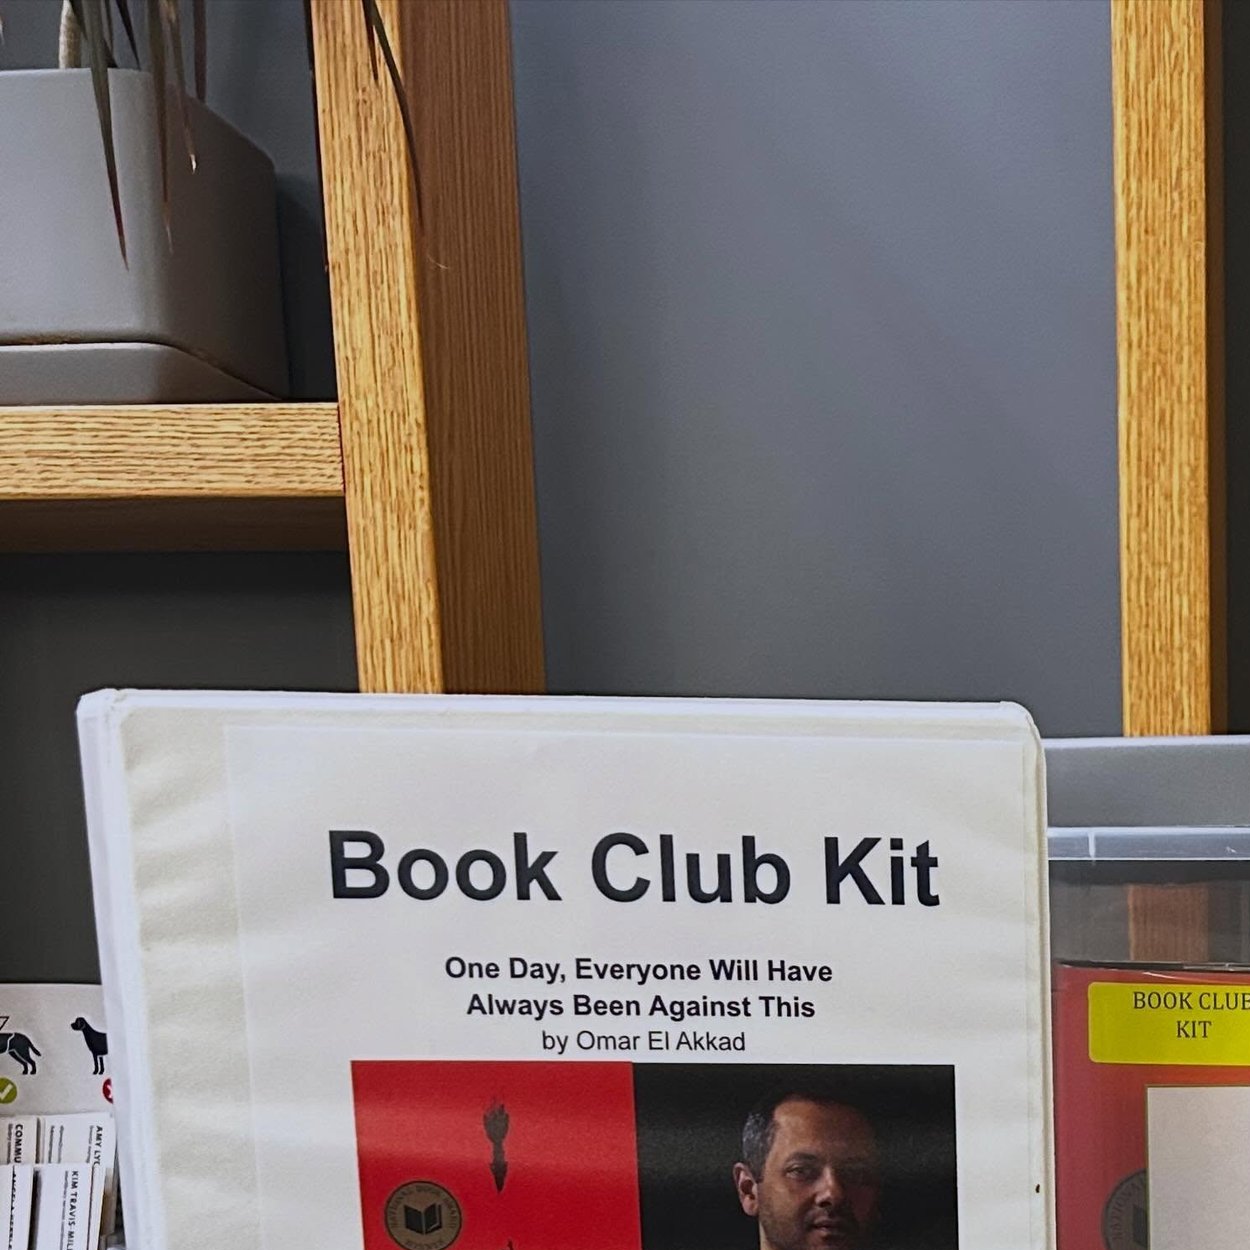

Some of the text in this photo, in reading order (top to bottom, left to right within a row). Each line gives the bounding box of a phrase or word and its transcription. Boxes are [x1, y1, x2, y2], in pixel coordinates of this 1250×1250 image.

[328, 830, 940, 907] Book Club Kit
[445, 956, 833, 986] One Day, Everyone Will Have
[467, 993, 815, 1023] Always Been Against This
[1133, 991, 1191, 1010] BOOK
[542, 1030, 746, 1054] by Omar El Akkad
[1176, 1020, 1212, 1038] KIT
[14, 1124, 23, 1164] COMMU
[95, 1125, 103, 1147] AMY
